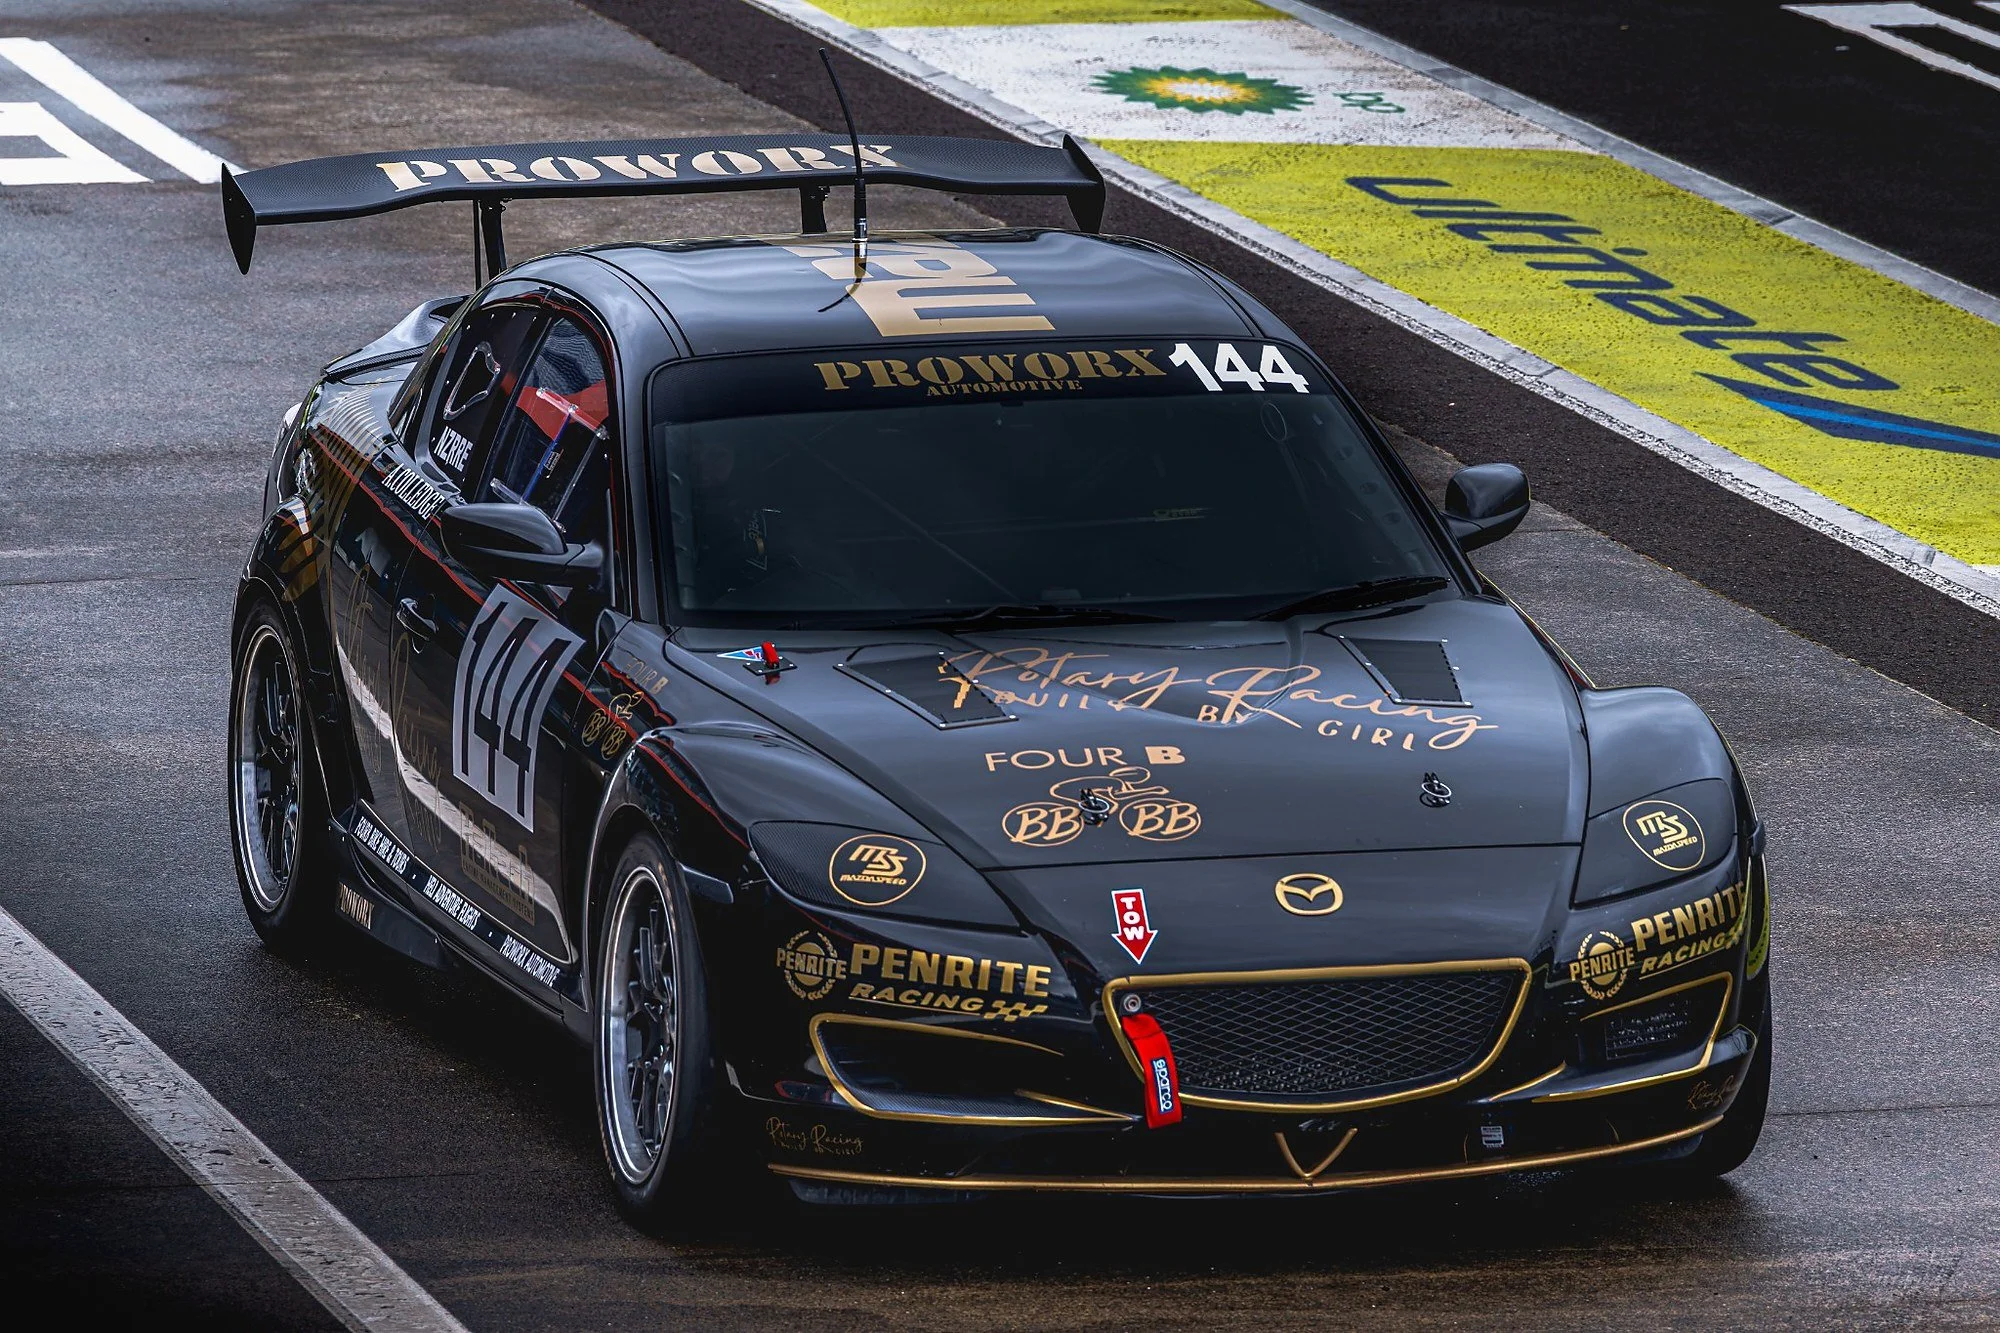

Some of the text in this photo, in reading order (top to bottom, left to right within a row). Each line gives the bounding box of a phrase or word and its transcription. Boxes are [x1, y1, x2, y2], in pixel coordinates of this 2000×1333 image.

[375, 144, 899, 193] PROWORX
[1344, 176, 1902, 391] ultimate
[812, 348, 1168, 392] PROWORX
[926, 379, 1084, 398] AUTOMOTIVE
[1167, 342, 1311, 394] 144
[462, 601, 572, 818] 144
[937, 647, 1500, 751] Rotary Racing
[984, 745, 1187, 772] FOUR B
[1010, 801, 1199, 843] BB BB
[385, 844, 397, 864] &
[1120, 896, 1145, 941] TOW
[499, 934, 561, 988] PROWORX AUTOMOTIVE
[776, 947, 848, 981] PENRITE
[849, 942, 1053, 998] PENRITE
[1567, 946, 1636, 982] PENRITE
[1640, 931, 1727, 974] RACING
[850, 982, 985, 1012] RACING
[1156, 1058, 1173, 1110] sparco
